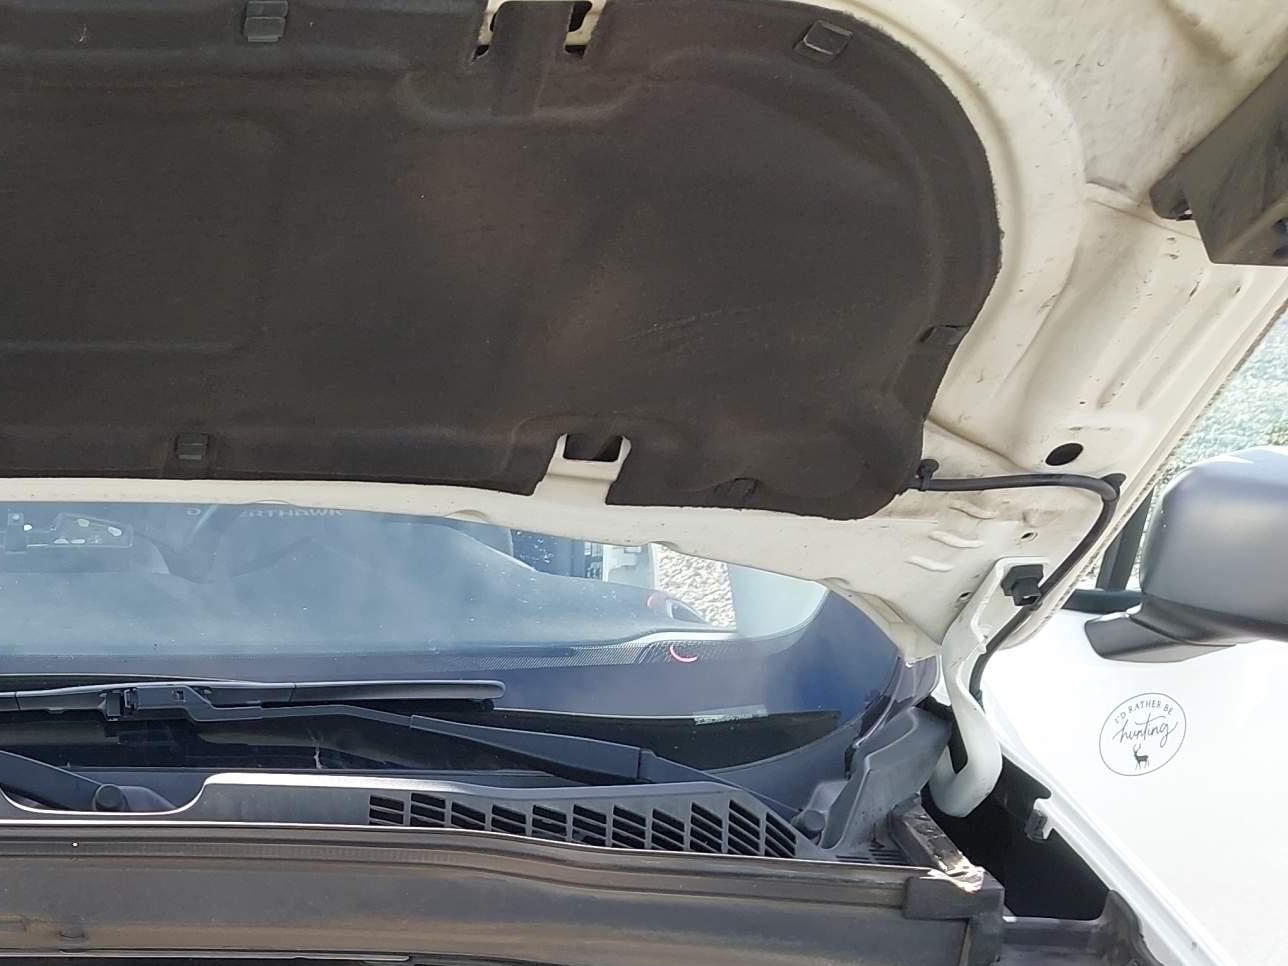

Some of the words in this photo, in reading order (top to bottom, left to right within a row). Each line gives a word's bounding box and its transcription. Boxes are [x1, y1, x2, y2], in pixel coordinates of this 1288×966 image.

[1128, 699, 1161, 713] RATHER
[1163, 703, 1174, 714] BE
[1112, 712, 1178, 748] hunting
